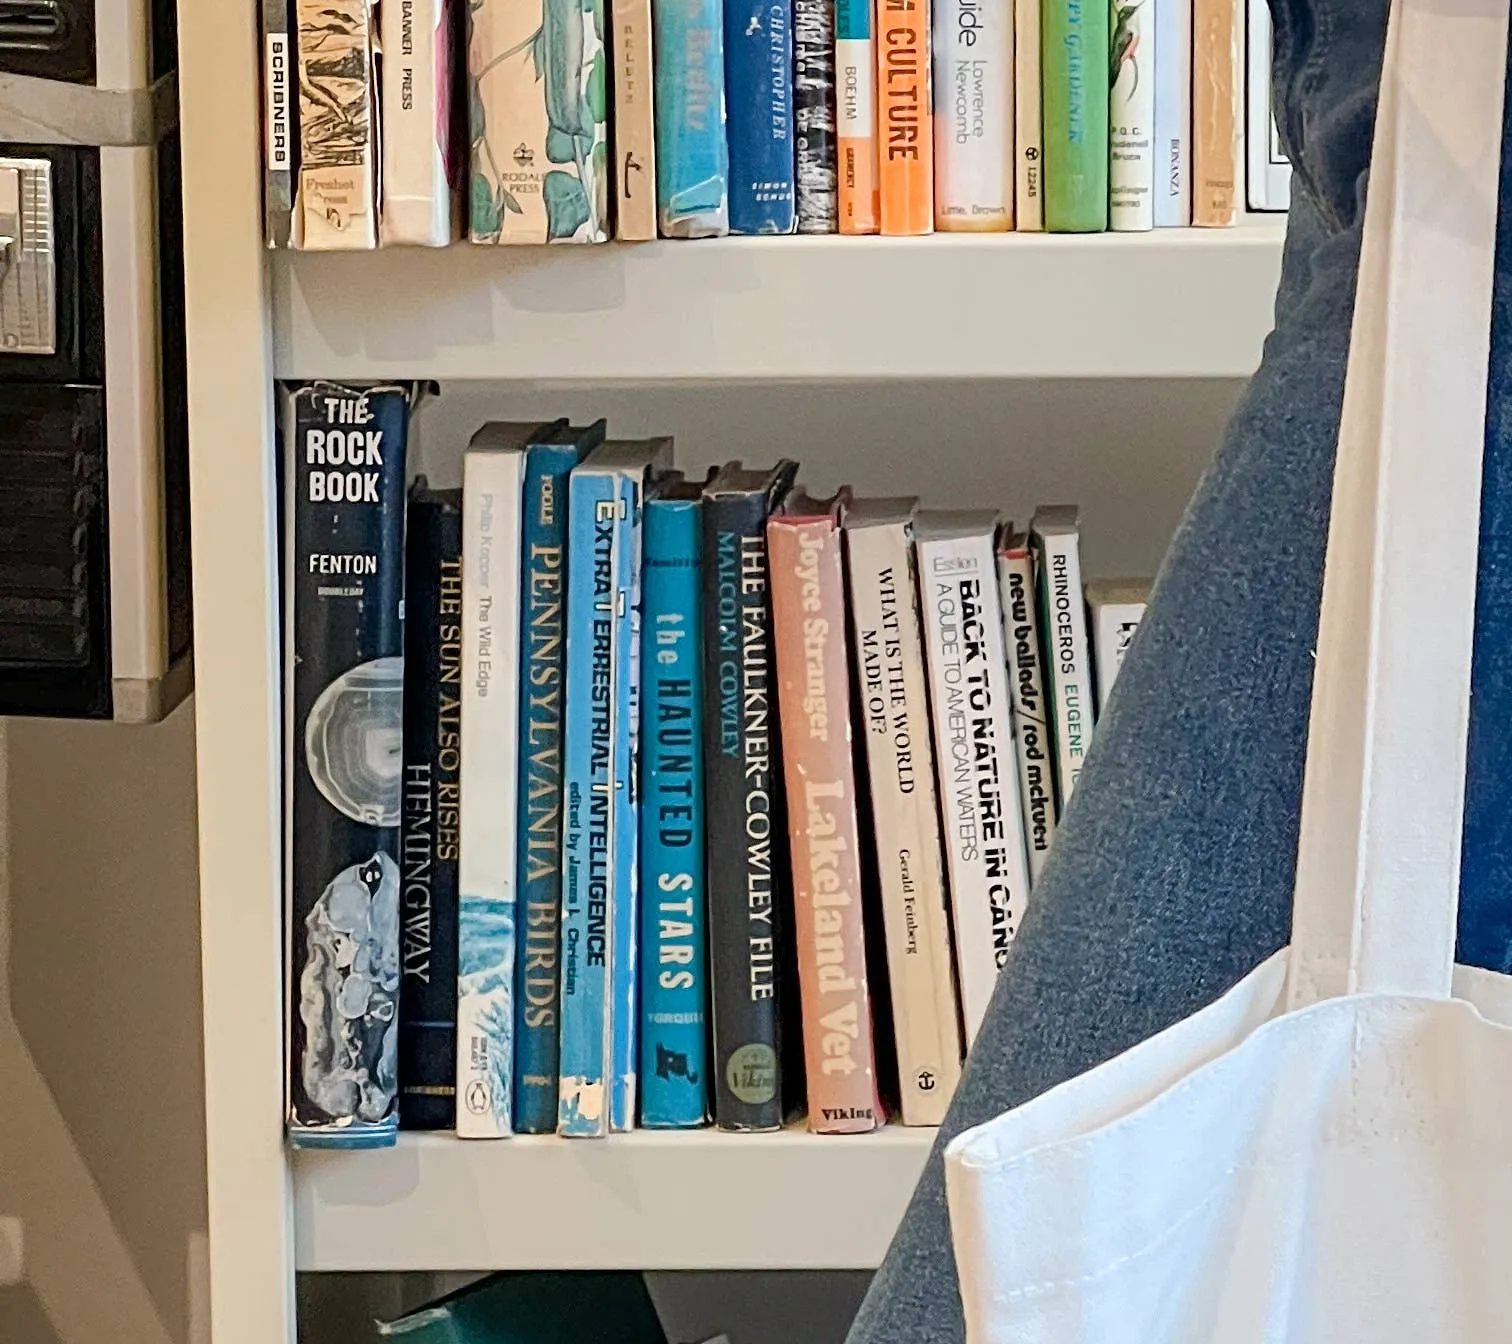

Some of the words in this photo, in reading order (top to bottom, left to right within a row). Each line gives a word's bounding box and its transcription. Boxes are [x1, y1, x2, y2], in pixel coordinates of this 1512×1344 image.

[401, 0, 413, 56] BANNER
[271, 41, 286, 163] SCRIBNERS
[401, 67, 413, 111] PRESS
[769, 5, 786, 140] CHRISTOPHER
[845, 65, 857, 121] BOEHM
[954, 59, 970, 145] Newcomb
[324, 397, 369, 424] THE
[306, 429, 384, 466] ROCK
[308, 470, 380, 503] BOOK
[309, 553, 377, 574] FENTON
[439, 558, 462, 615] THE
[716, 532, 738, 652] MALCOLM
[741, 535, 766, 595] THE
[794, 531, 825, 612] Joyce
[478, 595, 492, 622] The
[877, 567, 901, 630] WHAT
[439, 624, 461, 683] SUN
[478, 626, 492, 657] Wild
[656, 612, 686, 665] the
[861, 630, 884, 693] MADE
[884, 638, 901, 658] IS
[475, 660, 492, 698] Edge
[720, 660, 743, 758] COWLEY
[802, 617, 829, 742] Stranger
[887, 660, 908, 710] THE
[437, 691, 461, 771] ALSO
[526, 542, 563, 882] PENNSYLVANIA
[869, 696, 888, 735] OF?
[656, 678, 694, 848] HAUNTED
[743, 605, 773, 924] FAULKNER-COWLEY
[892, 712, 915, 795] WORLD
[436, 781, 460, 861] RISES
[403, 762, 432, 984] HEMINGWAY
[805, 779, 857, 994] Lakeland
[899, 848, 915, 895] Gerald
[657, 872, 694, 990] STARS
[902, 896, 919, 956] Feinberg
[524, 900, 559, 1029] BIRDS
[749, 936, 775, 1001] FILE
[819, 1001, 859, 1076] Vet
[821, 1107, 873, 1121] Viking
